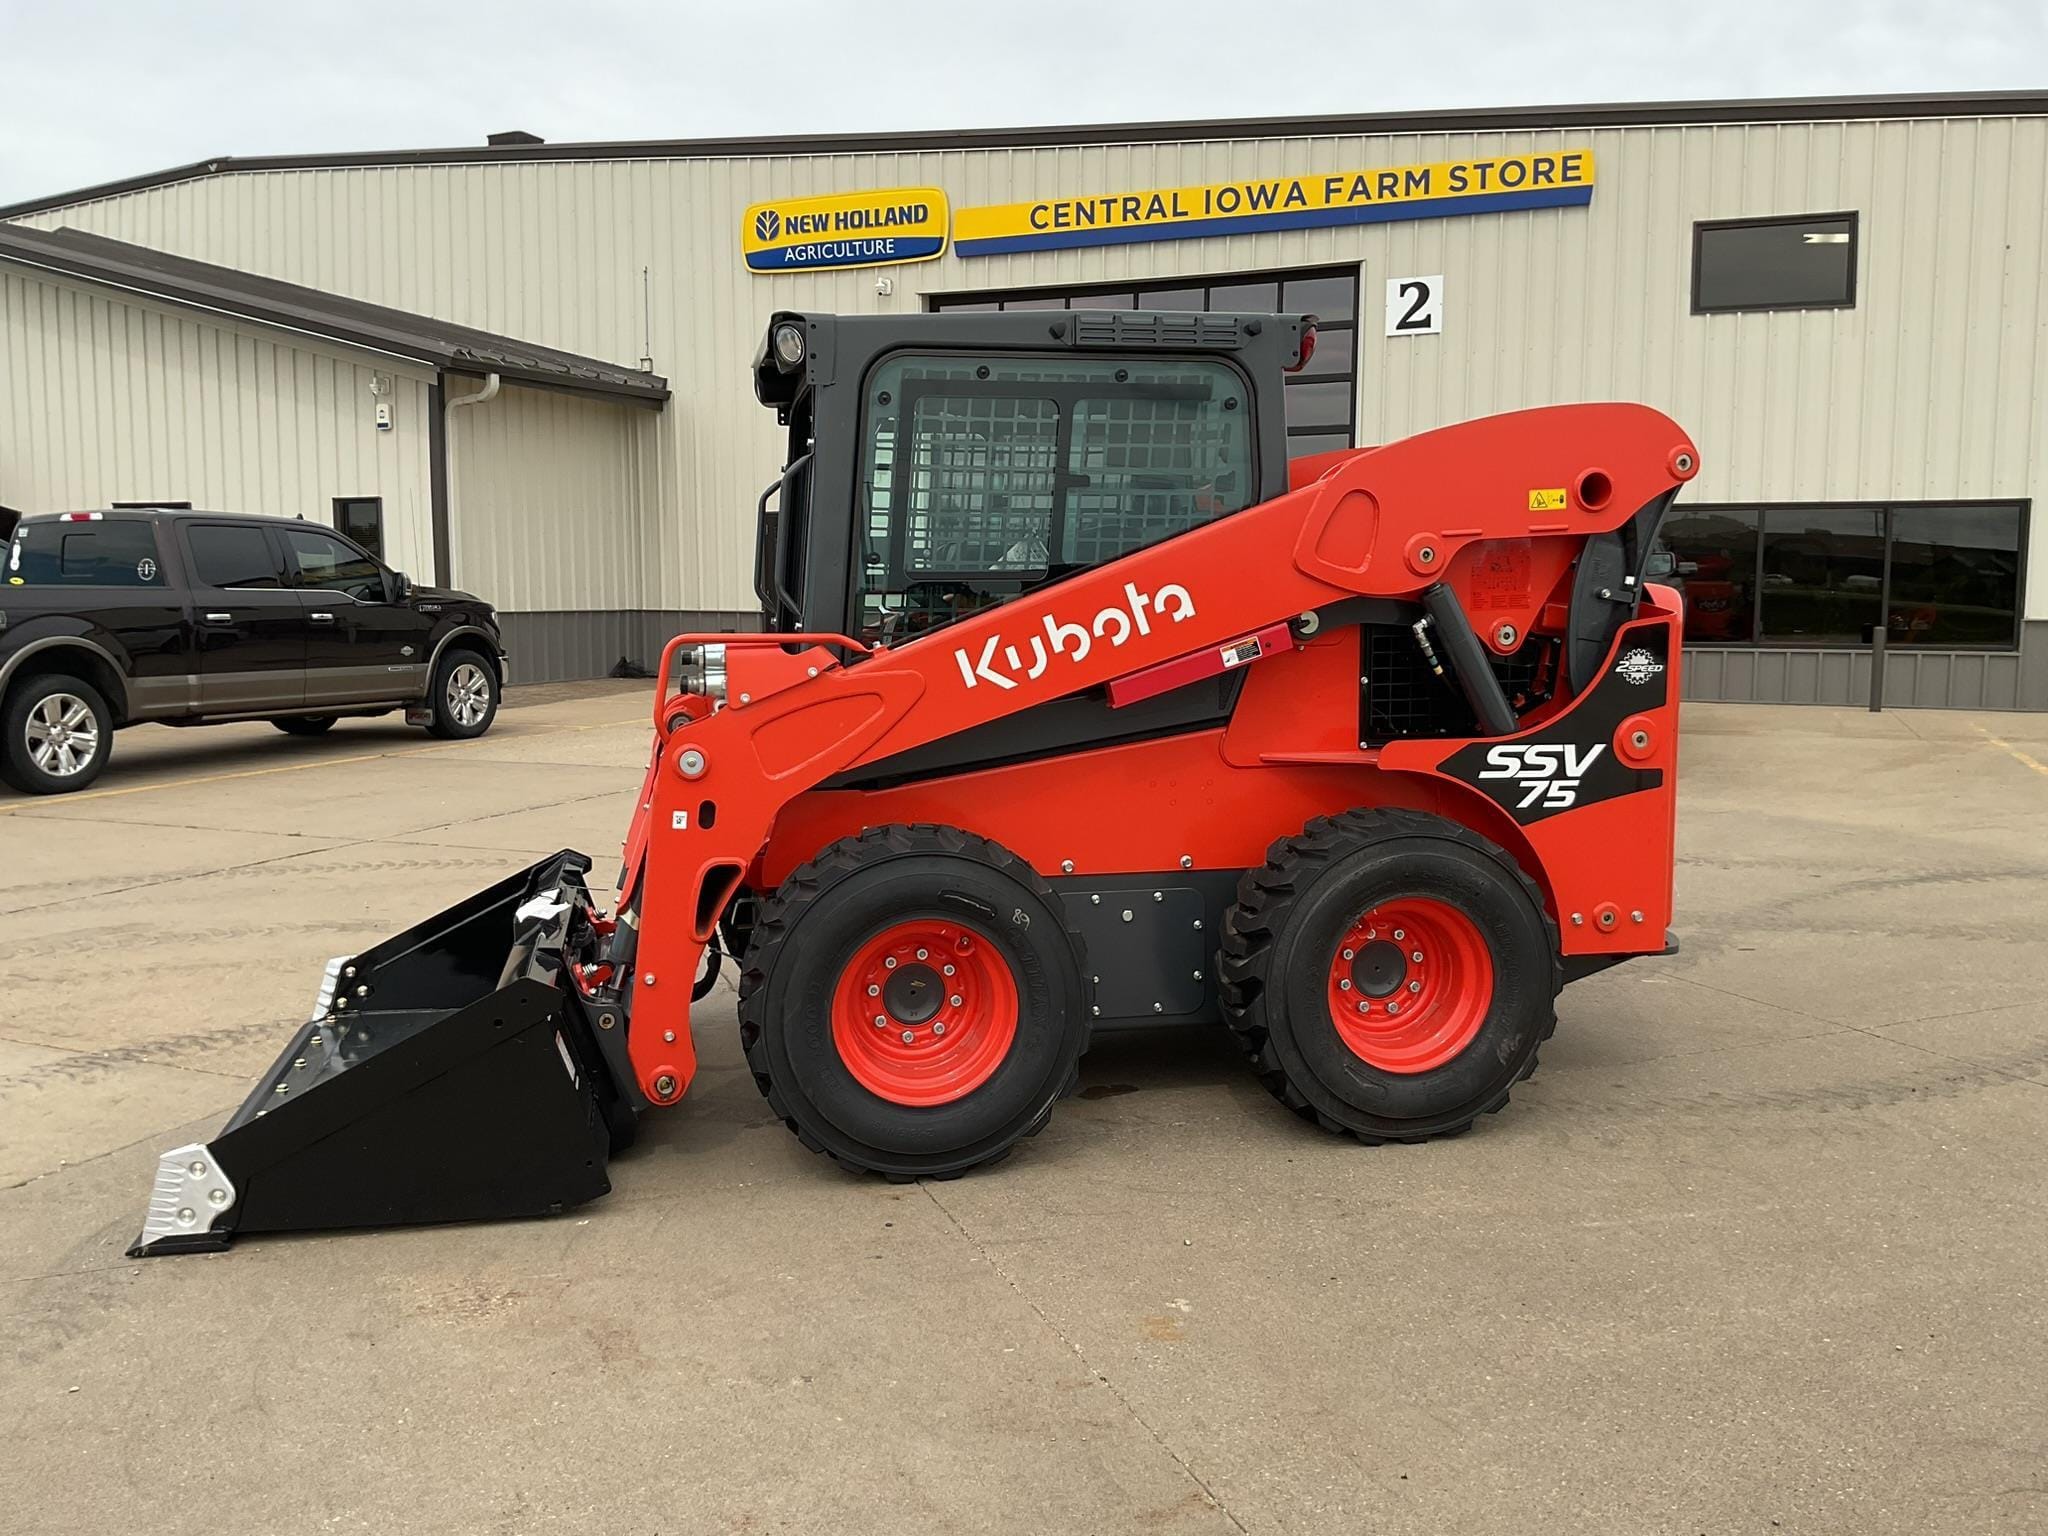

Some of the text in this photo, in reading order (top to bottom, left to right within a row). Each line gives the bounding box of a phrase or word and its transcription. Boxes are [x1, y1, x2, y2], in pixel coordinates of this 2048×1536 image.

[1029, 154, 1583, 230] CENTRAL IOWA FARM STORE
[785, 204, 929, 236] NEW HOLLAND
[784, 238, 895, 262] AGRICULTURE
[1395, 281, 1432, 331] 2
[953, 581, 1197, 690] Kubota
[1477, 743, 1608, 779] SSV
[1515, 779, 1581, 809] 75
